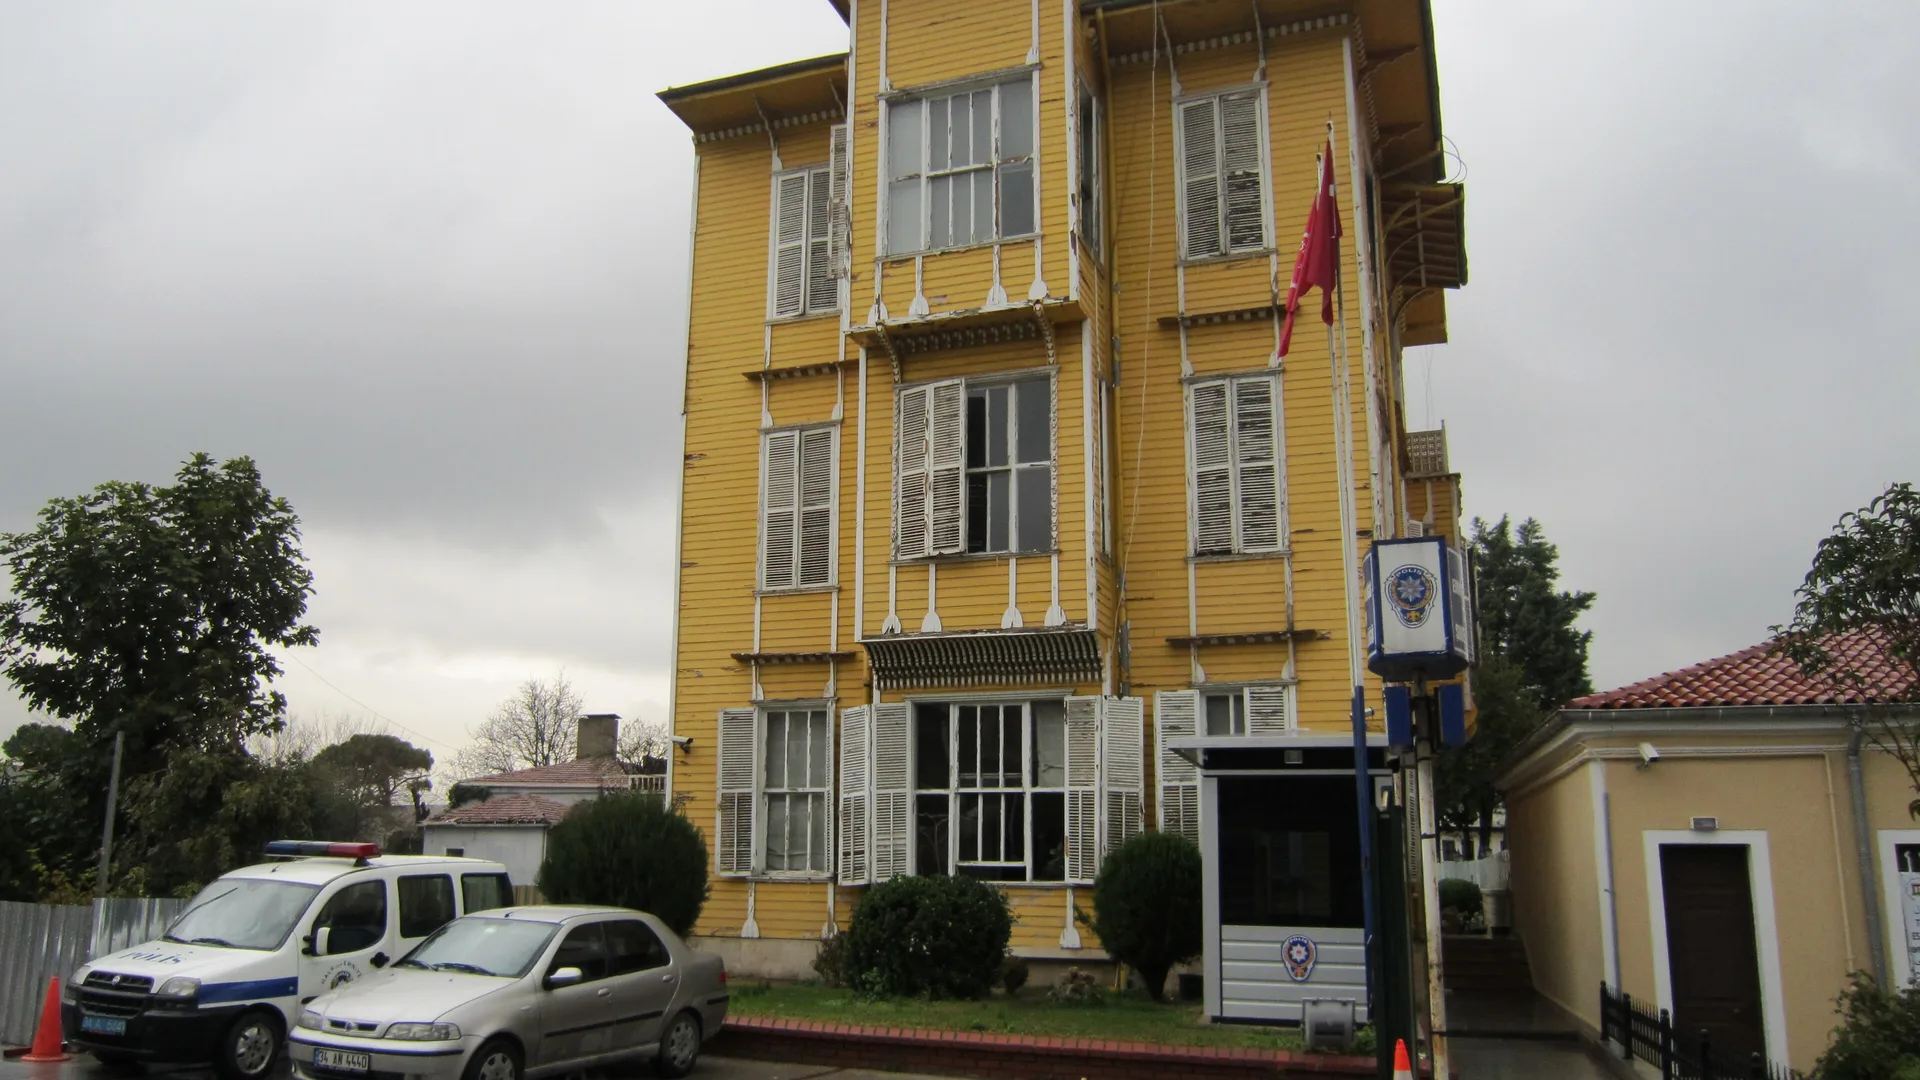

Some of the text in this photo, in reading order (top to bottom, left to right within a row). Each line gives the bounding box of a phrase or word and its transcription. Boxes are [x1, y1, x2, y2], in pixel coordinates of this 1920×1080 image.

[319, 1050, 367, 1069] 34 AN 4440
